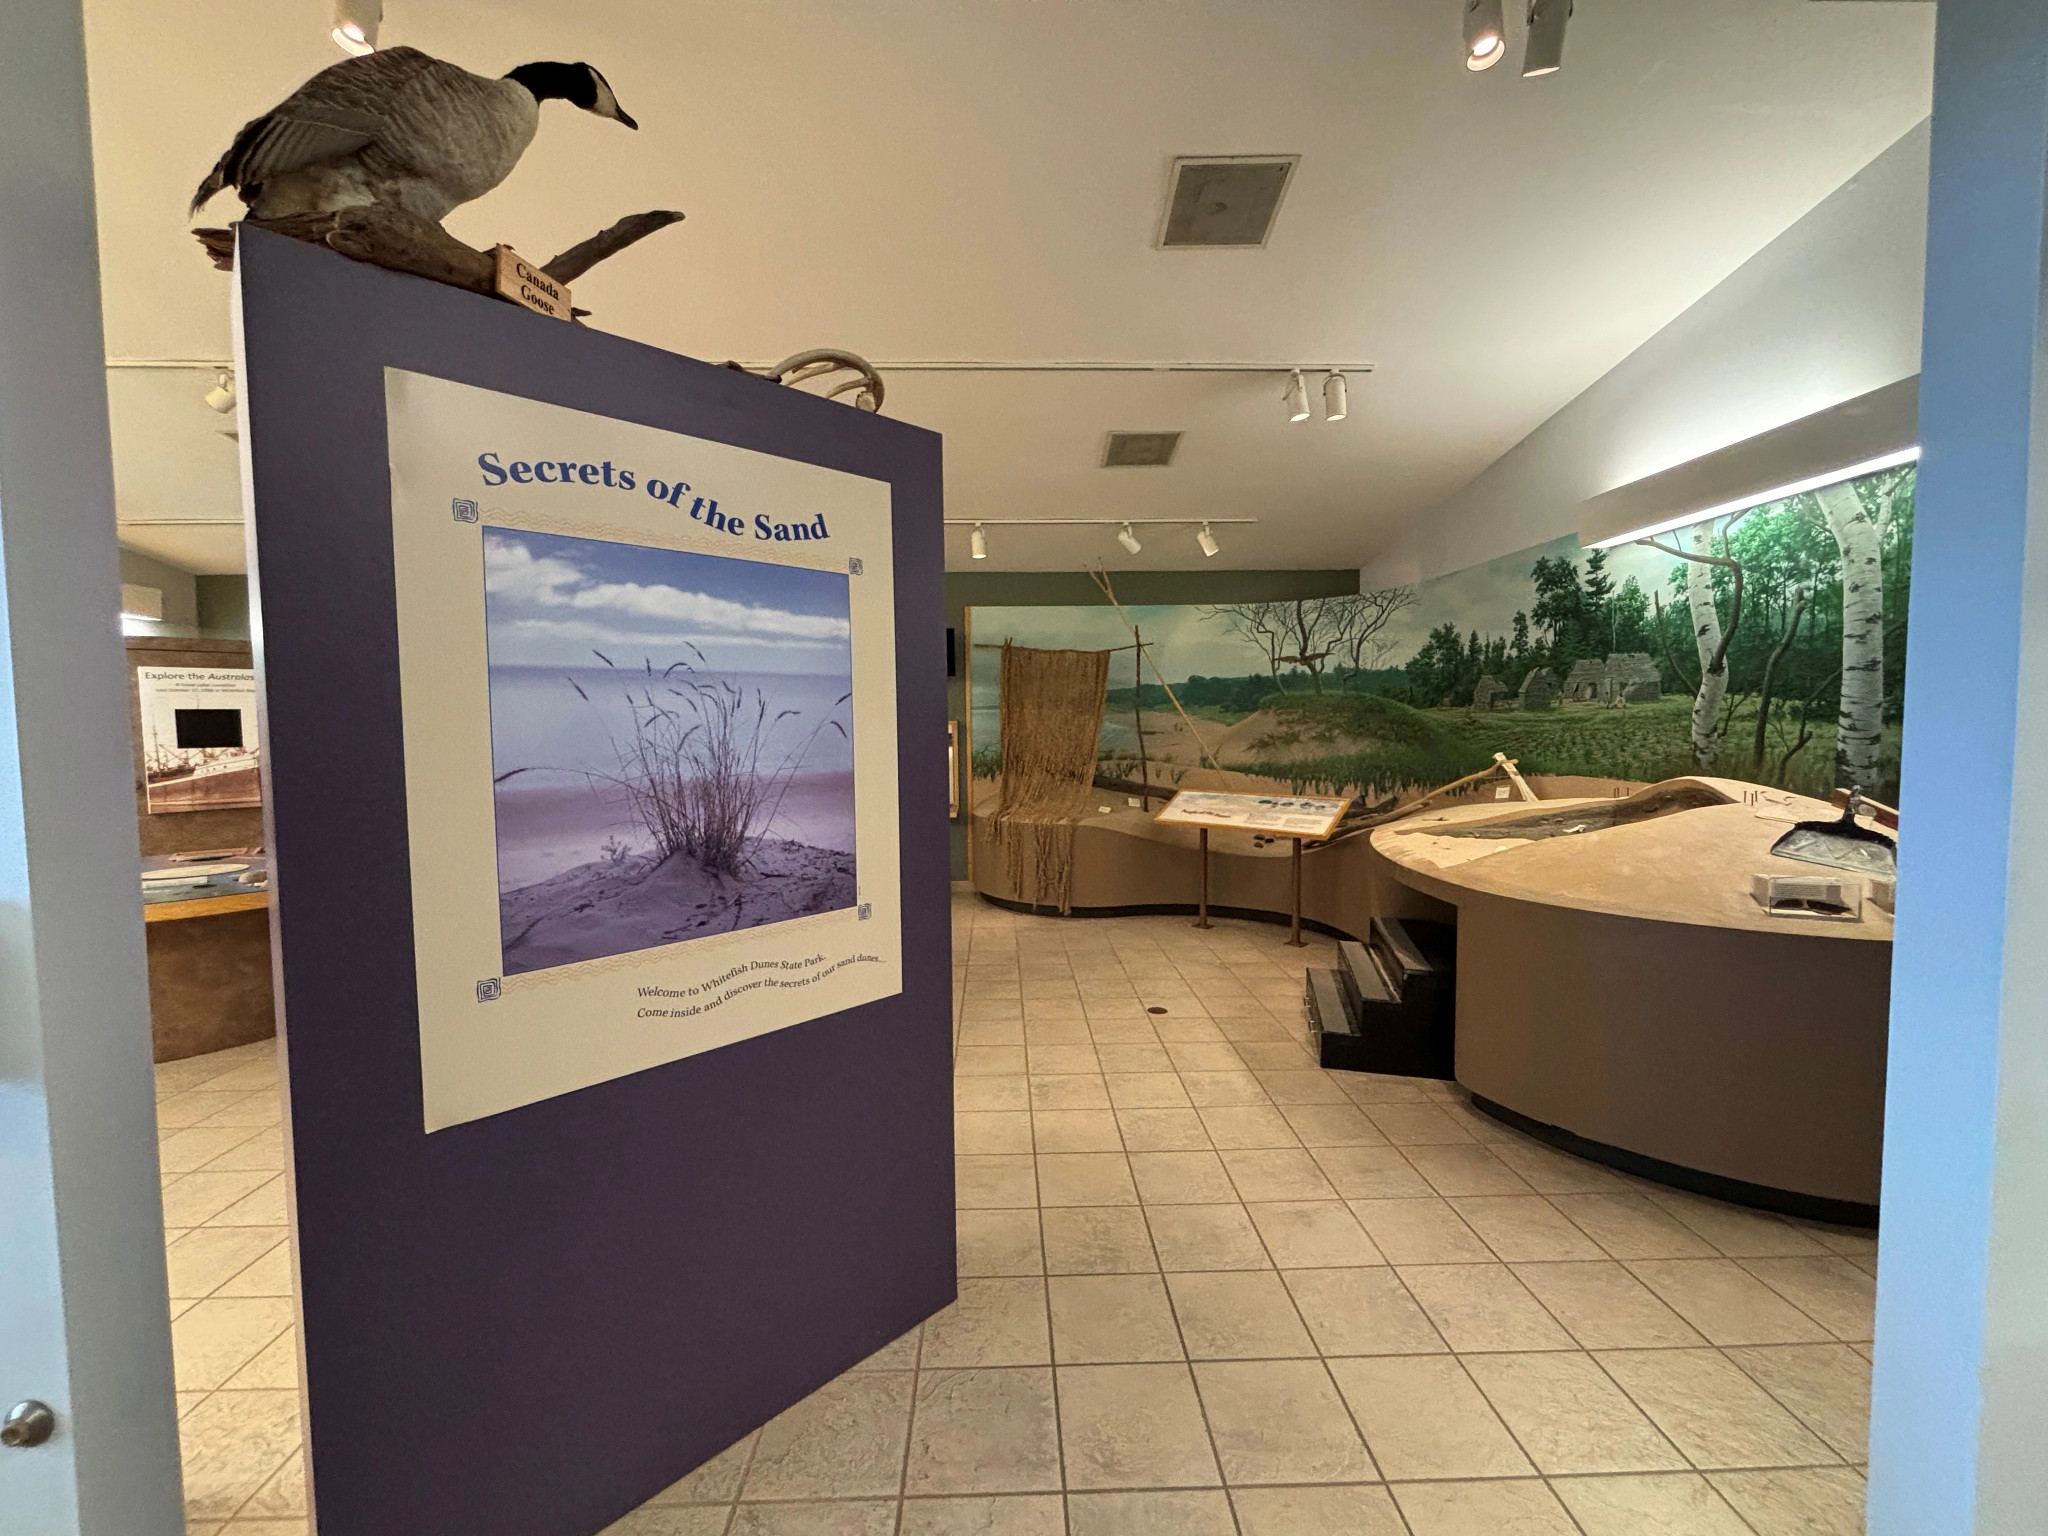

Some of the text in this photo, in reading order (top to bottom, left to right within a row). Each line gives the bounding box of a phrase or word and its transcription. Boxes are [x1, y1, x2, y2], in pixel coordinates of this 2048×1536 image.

[516, 263, 559, 300] Canada
[521, 285, 554, 315] Goose
[478, 451, 831, 542] Secrets of the Sand
[145, 672, 185, 681] Explore
[188, 672, 205, 681] the
[637, 953, 827, 998] Welcome to Whitefish Dunes State Park.
[637, 1007, 669, 1018] Come
[670, 1006, 702, 1018] inside
[704, 996, 723, 1012] and
[724, 979, 762, 1001] discover
[764, 977, 779, 988] the
[779, 977, 811, 989] secrets
[811, 970, 823, 983] of
[822, 965, 836, 978] our
[836, 954, 857, 969] sand
